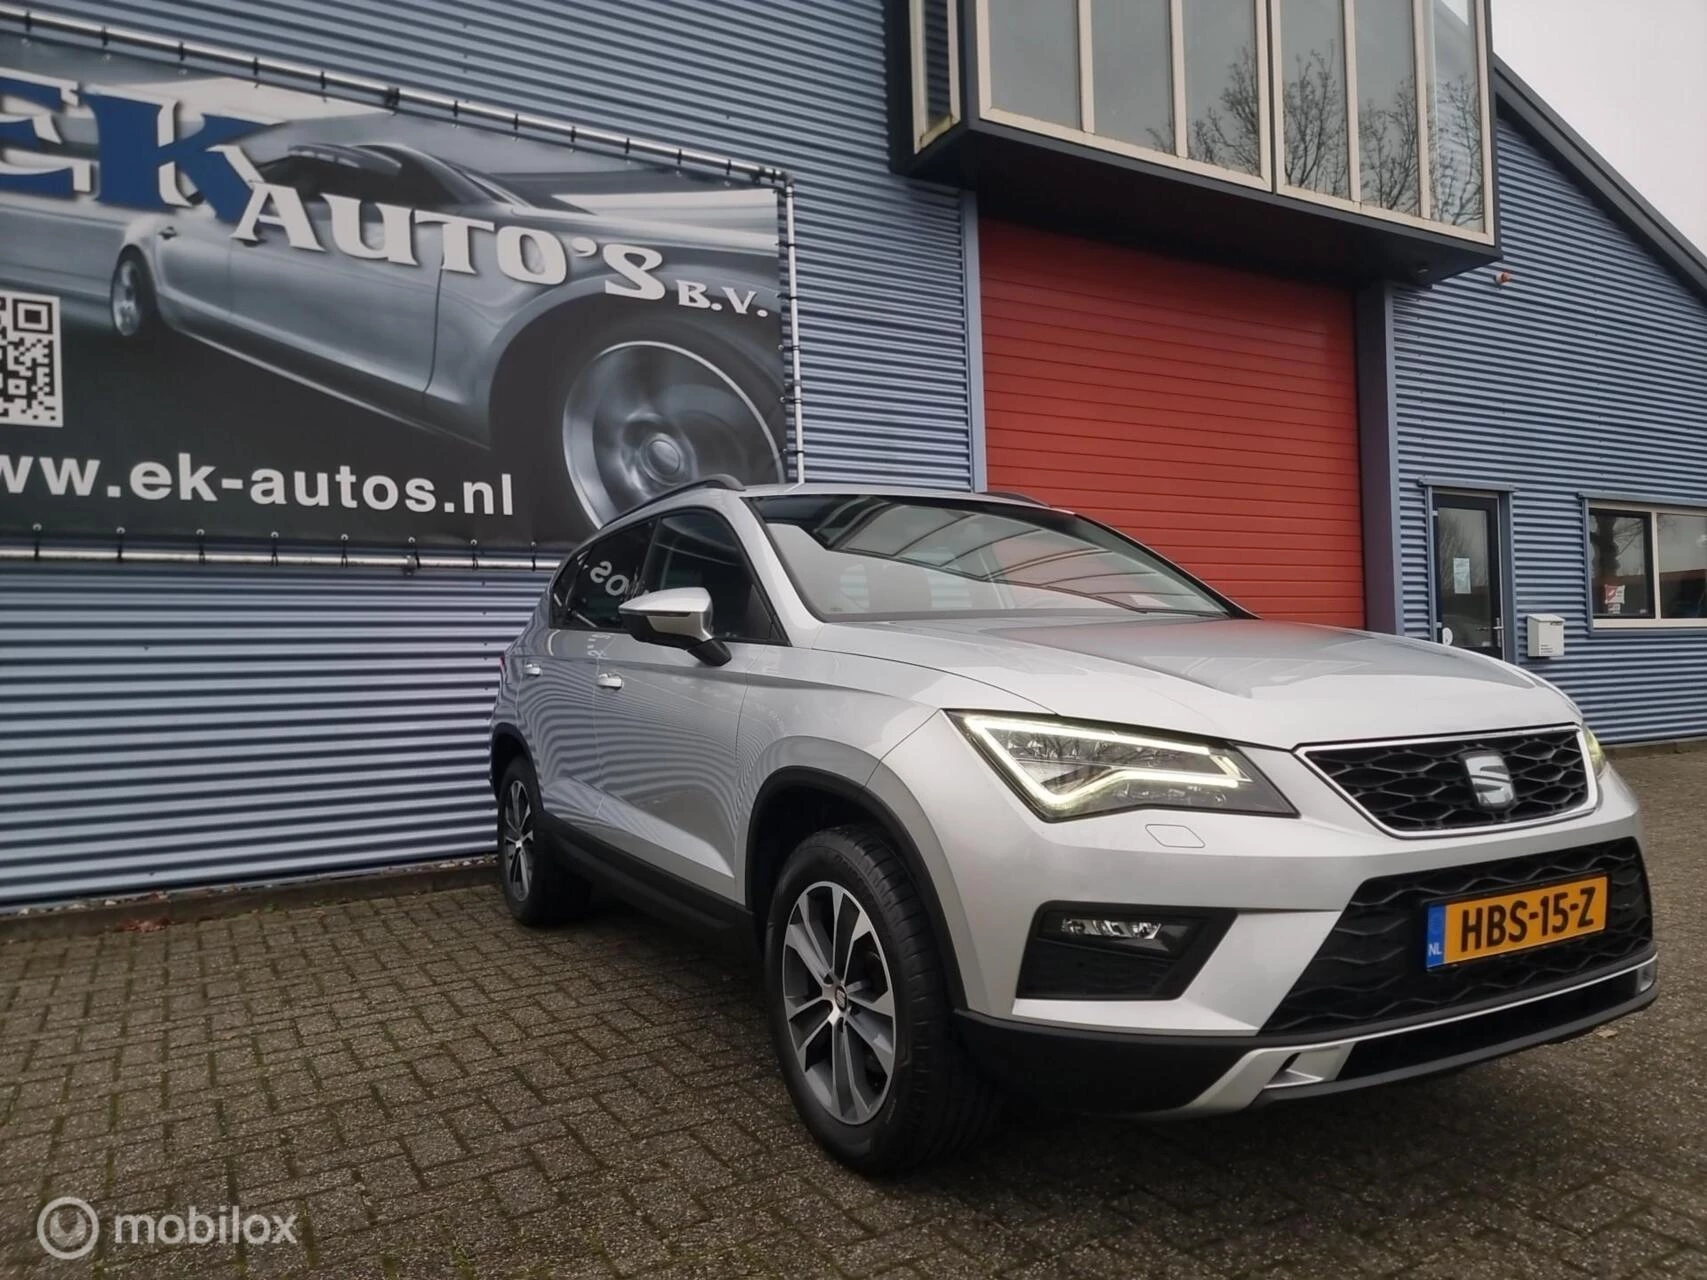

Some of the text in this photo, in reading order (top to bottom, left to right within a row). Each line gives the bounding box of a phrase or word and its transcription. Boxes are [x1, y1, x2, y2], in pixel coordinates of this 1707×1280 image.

[676, 279, 769, 318] B.V.
[1460, 886, 1596, 953] HBS-15-Z
[1427, 942, 1443, 956] NL
